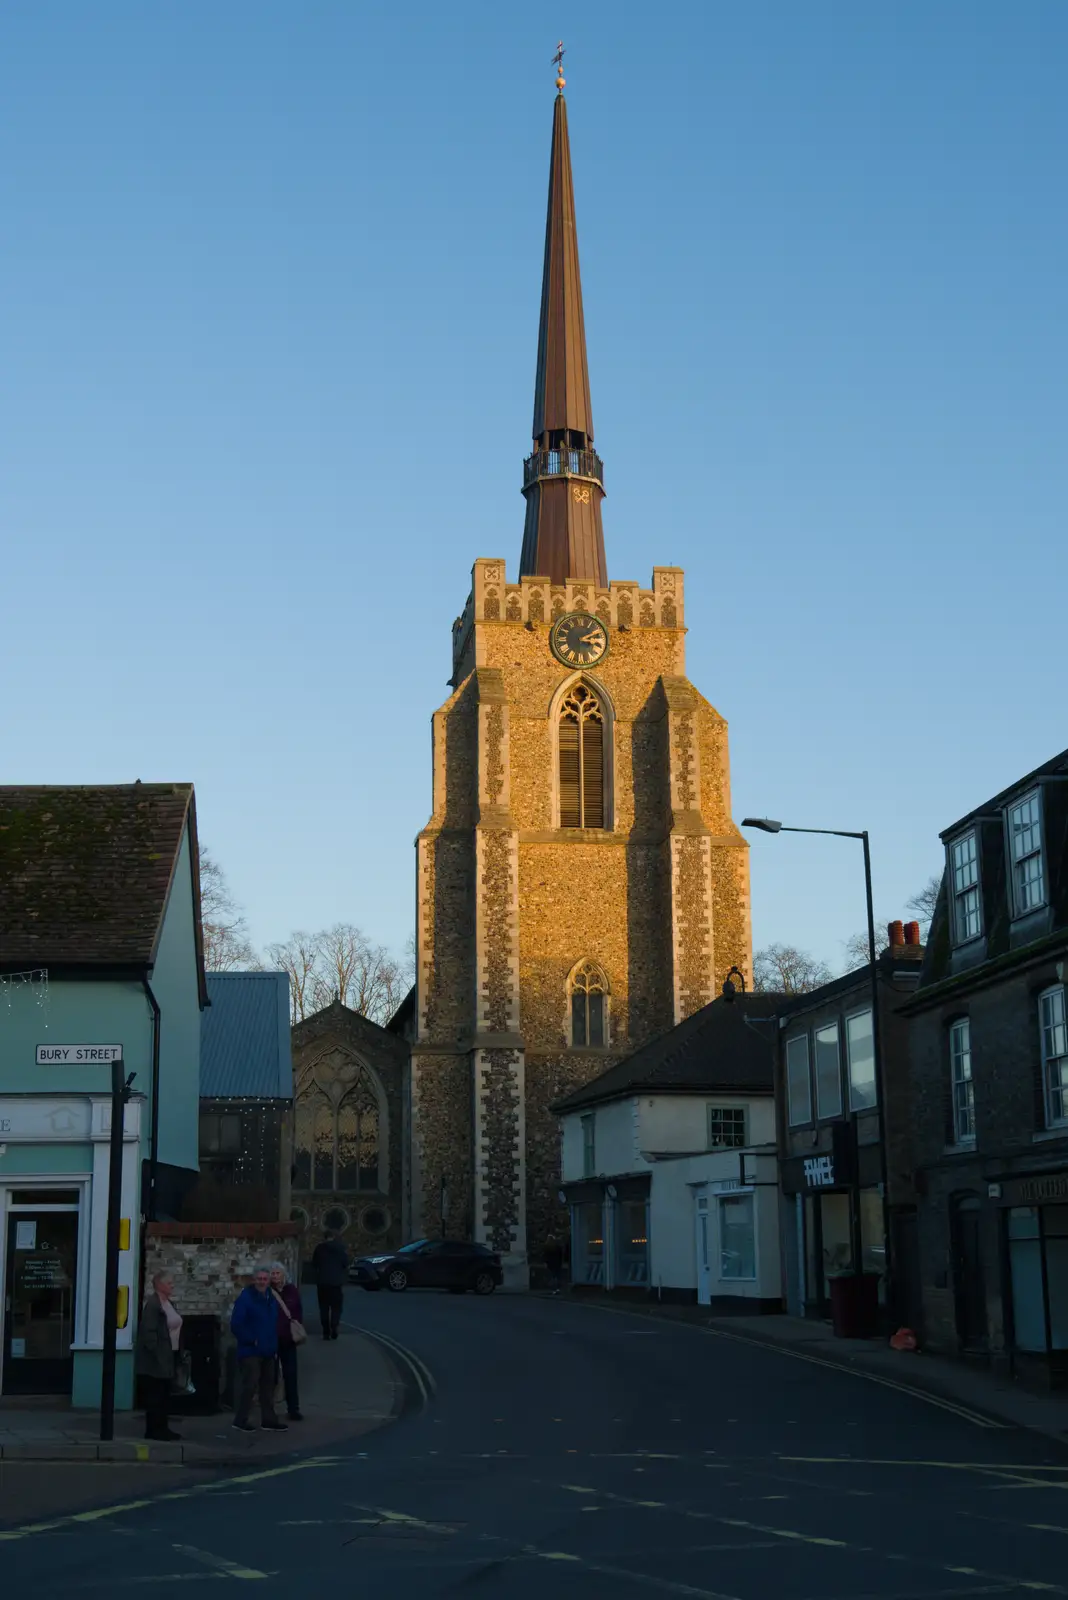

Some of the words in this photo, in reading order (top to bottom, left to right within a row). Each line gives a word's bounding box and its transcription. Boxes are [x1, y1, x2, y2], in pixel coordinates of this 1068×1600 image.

[40, 1049, 69, 1059] BURY
[76, 1049, 118, 1059] STREET
[803, 1156, 835, 1187] TWEL
